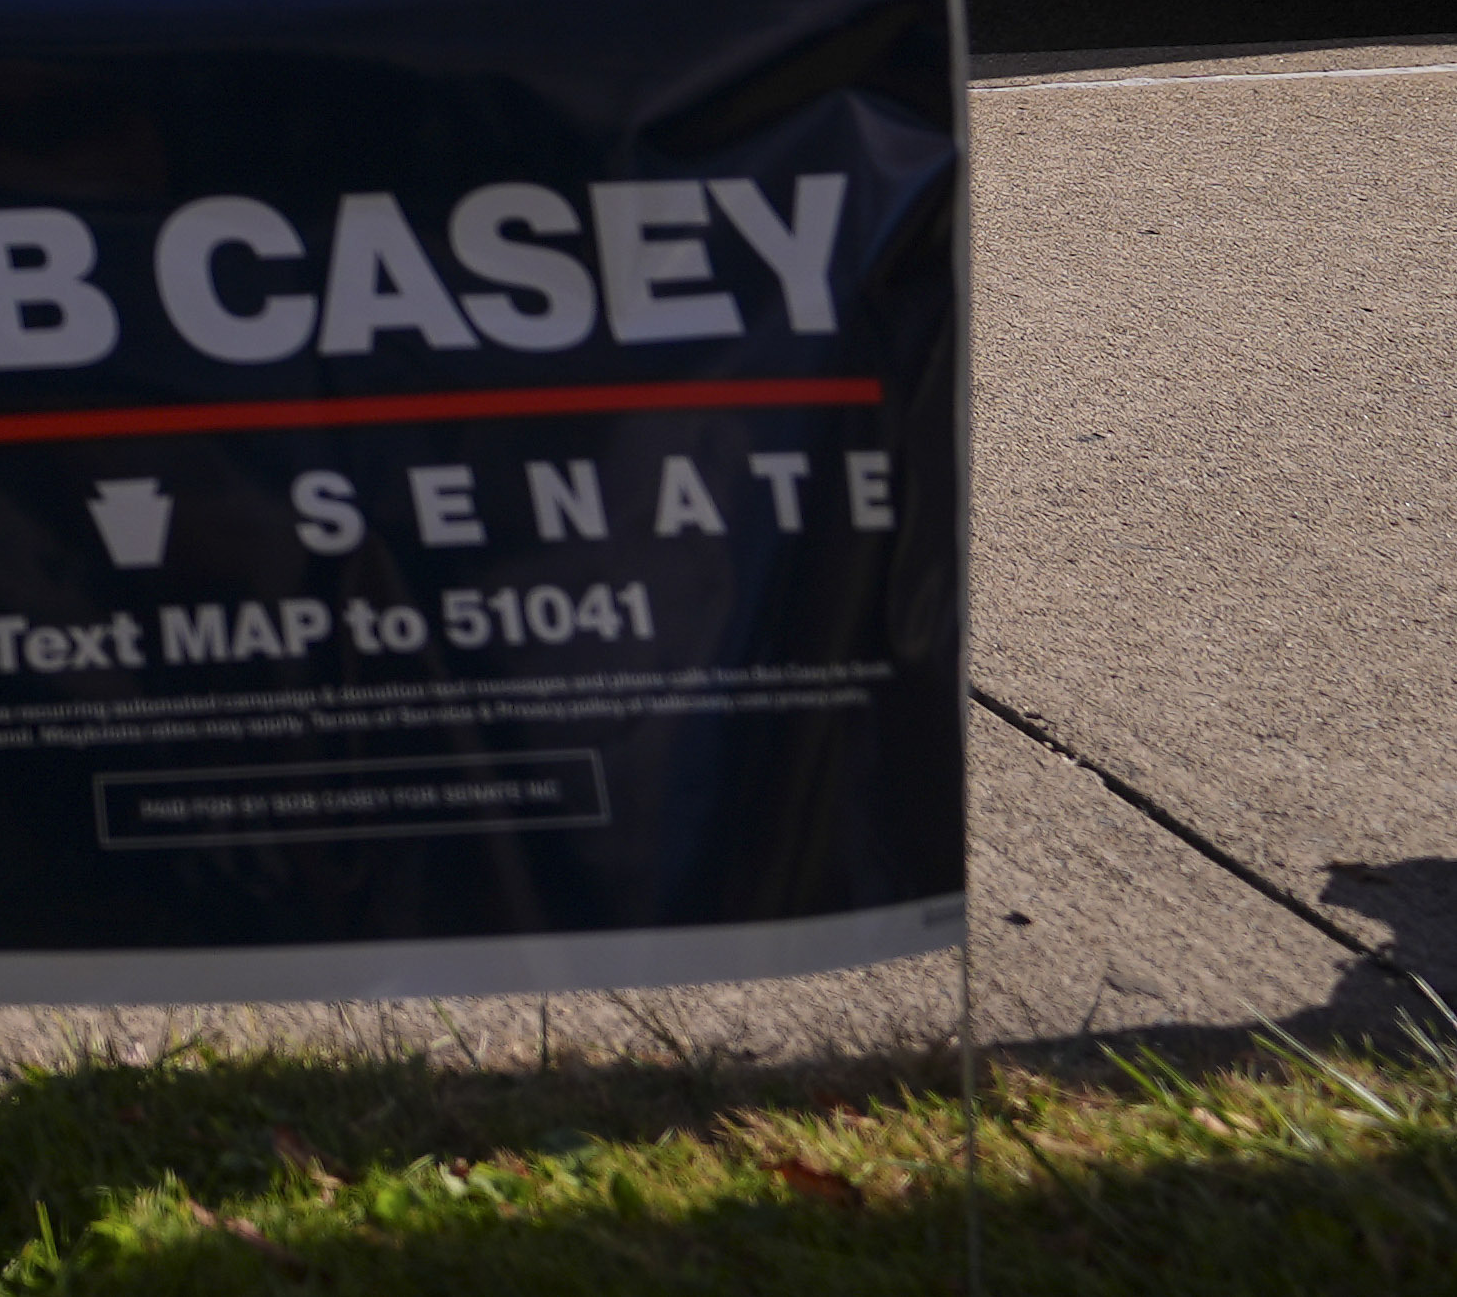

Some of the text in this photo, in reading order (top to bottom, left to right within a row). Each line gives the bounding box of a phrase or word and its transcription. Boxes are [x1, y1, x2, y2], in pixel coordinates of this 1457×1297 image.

[153, 173, 847, 365] CASEY
[294, 451, 895, 557] SENATE
[155, 596, 329, 667] MAP
[344, 596, 432, 655] to
[441, 580, 656, 649] 51041
